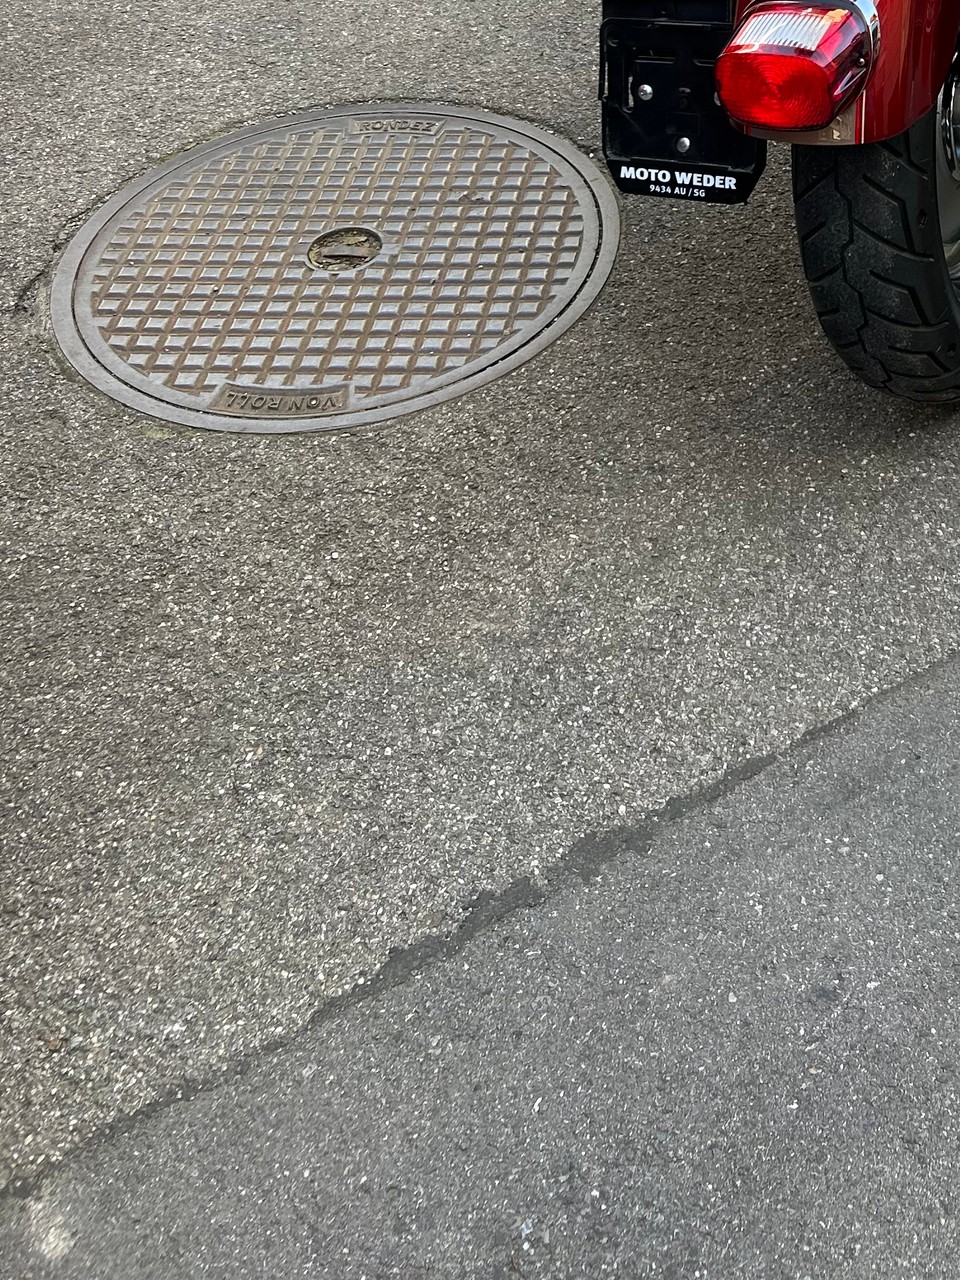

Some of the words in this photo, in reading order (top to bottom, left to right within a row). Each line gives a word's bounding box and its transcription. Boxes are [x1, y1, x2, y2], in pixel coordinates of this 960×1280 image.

[355, 119, 439, 132] RONDEZ
[620, 166, 671, 183] MOTO
[675, 171, 737, 190] WEDER
[649, 185, 672, 195] 9434
[673, 186, 687, 196] AU
[693, 188, 706, 198] SG
[226, 391, 282, 411] ROLL
[288, 396, 337, 412] VON
